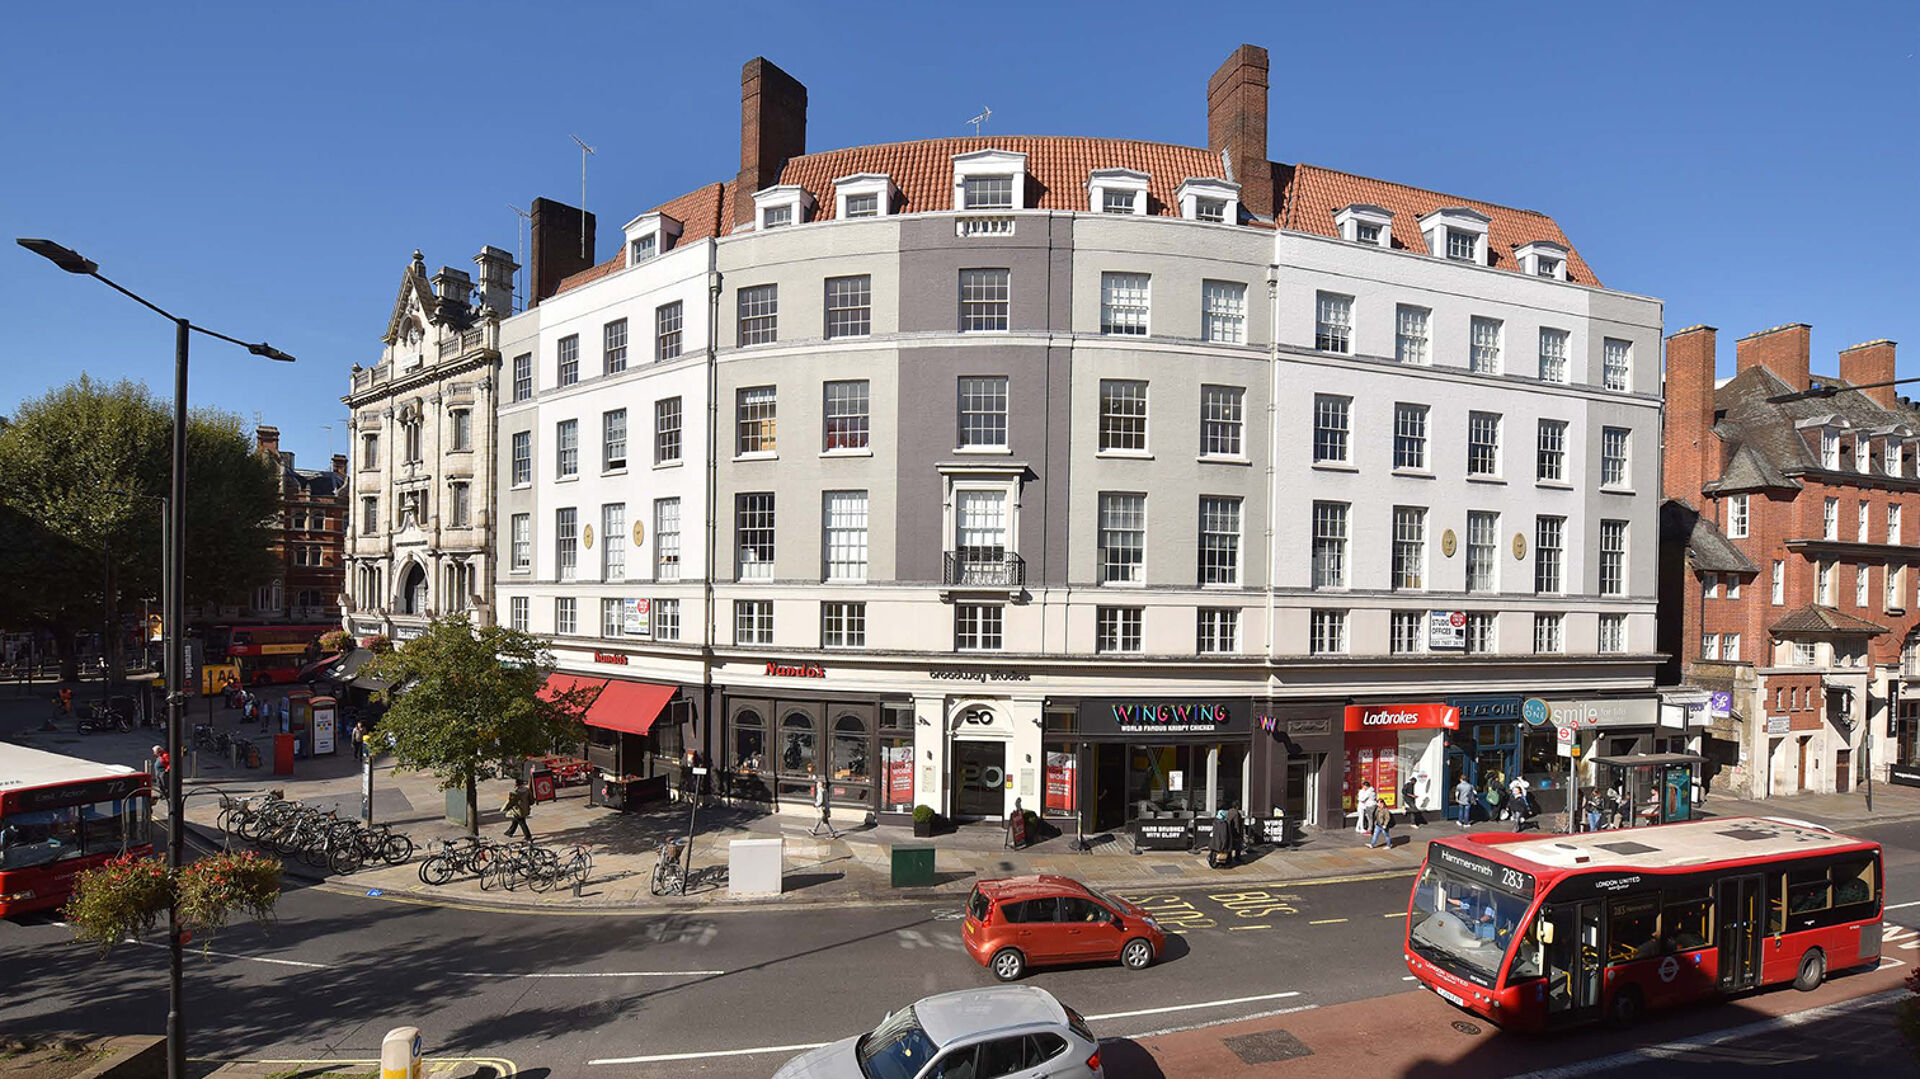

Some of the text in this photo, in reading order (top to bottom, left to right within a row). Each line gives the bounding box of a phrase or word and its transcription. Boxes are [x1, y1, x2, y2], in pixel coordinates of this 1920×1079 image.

[594, 650, 628, 665] Nando's
[764, 661, 826, 678] Nando's
[929, 668, 1031, 683] broadway studios
[966, 709, 994, 726] 20
[1363, 711, 1418, 725] Ladbrokes
[1525, 710, 1544, 720] ONE
[1554, 703, 1597, 724] smile
[106, 780, 126, 794] 72
[1441, 850, 1524, 890] Hammersmith 283
[1595, 880, 1618, 888] LONDON
[1619, 876, 1641, 884] UNITED
[1125, 894, 1218, 929] STOP
[1208, 891, 1299, 918] BUS
